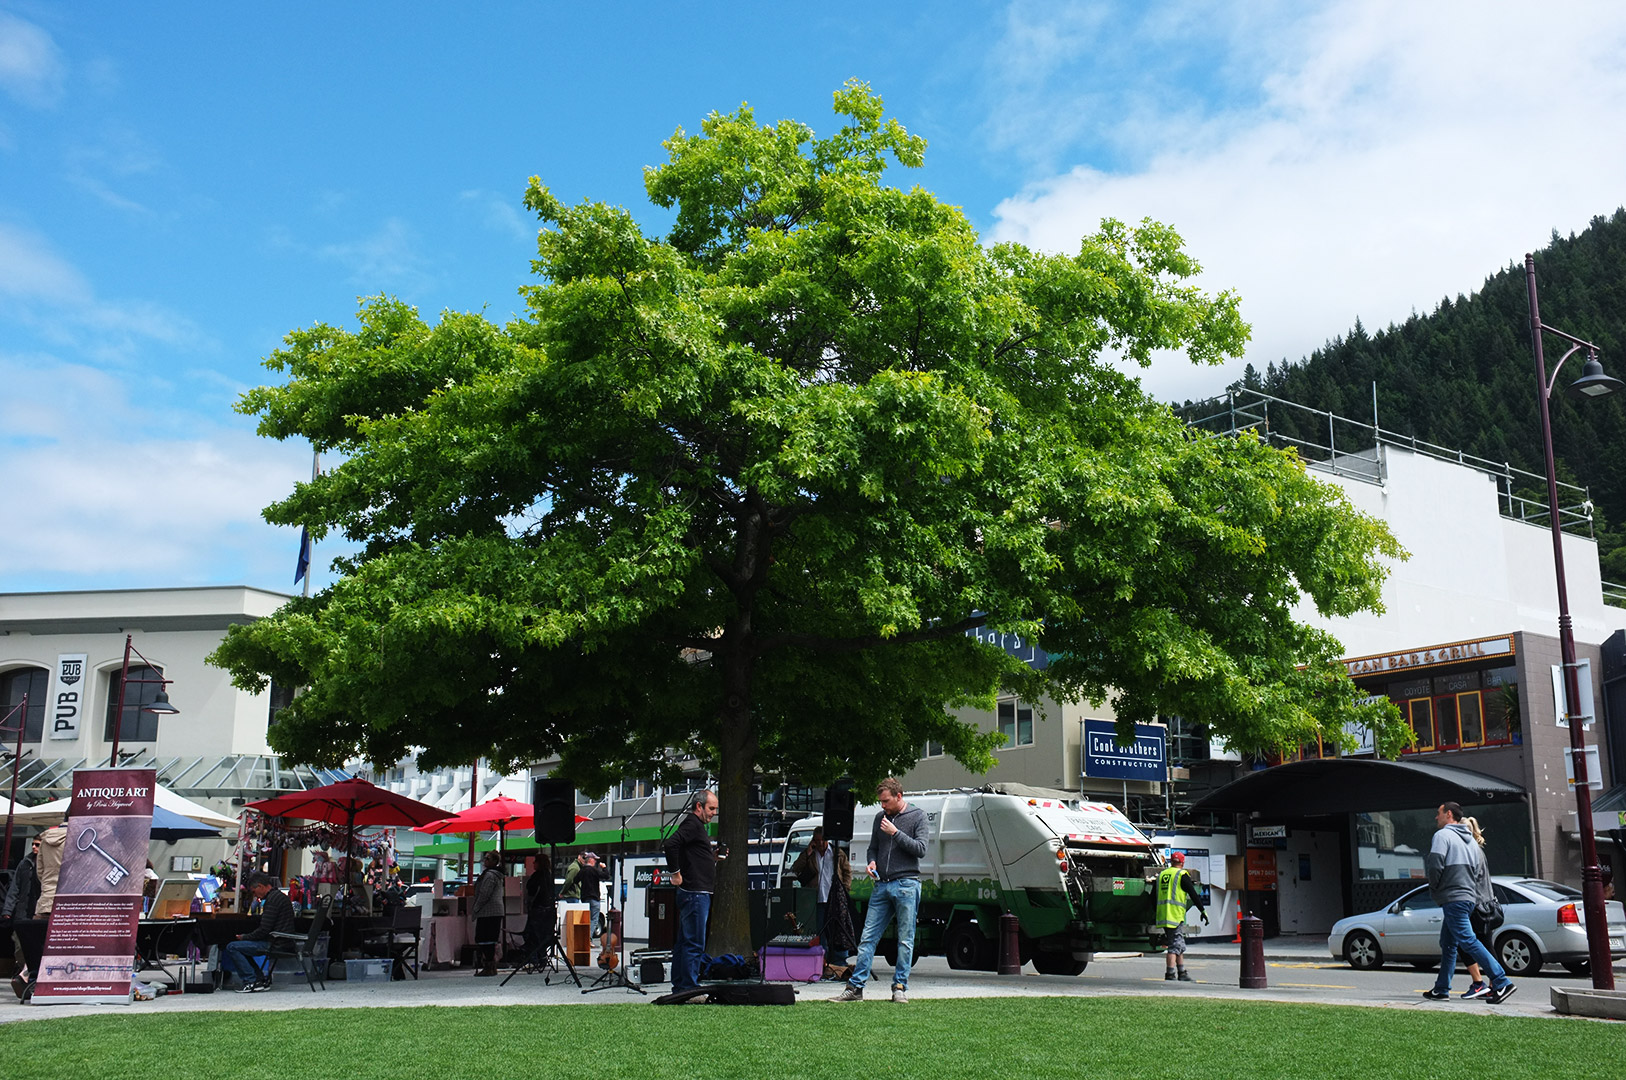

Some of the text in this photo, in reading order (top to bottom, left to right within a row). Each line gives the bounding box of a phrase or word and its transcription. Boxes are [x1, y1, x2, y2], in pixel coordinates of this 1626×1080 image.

[1347, 643, 1485, 674] ICAN BAR & GRILL
[62, 662, 82, 676] PUB
[1404, 685, 1431, 697] COYOTE
[1448, 680, 1468, 691] CASA
[1486, 675, 1503, 686] BAR
[54, 691, 79, 732] PUB
[1094, 737, 1114, 752] Cook
[1094, 758, 1159, 768] CONSTRUCTION
[77, 787, 149, 800] ANTIQUE ART
